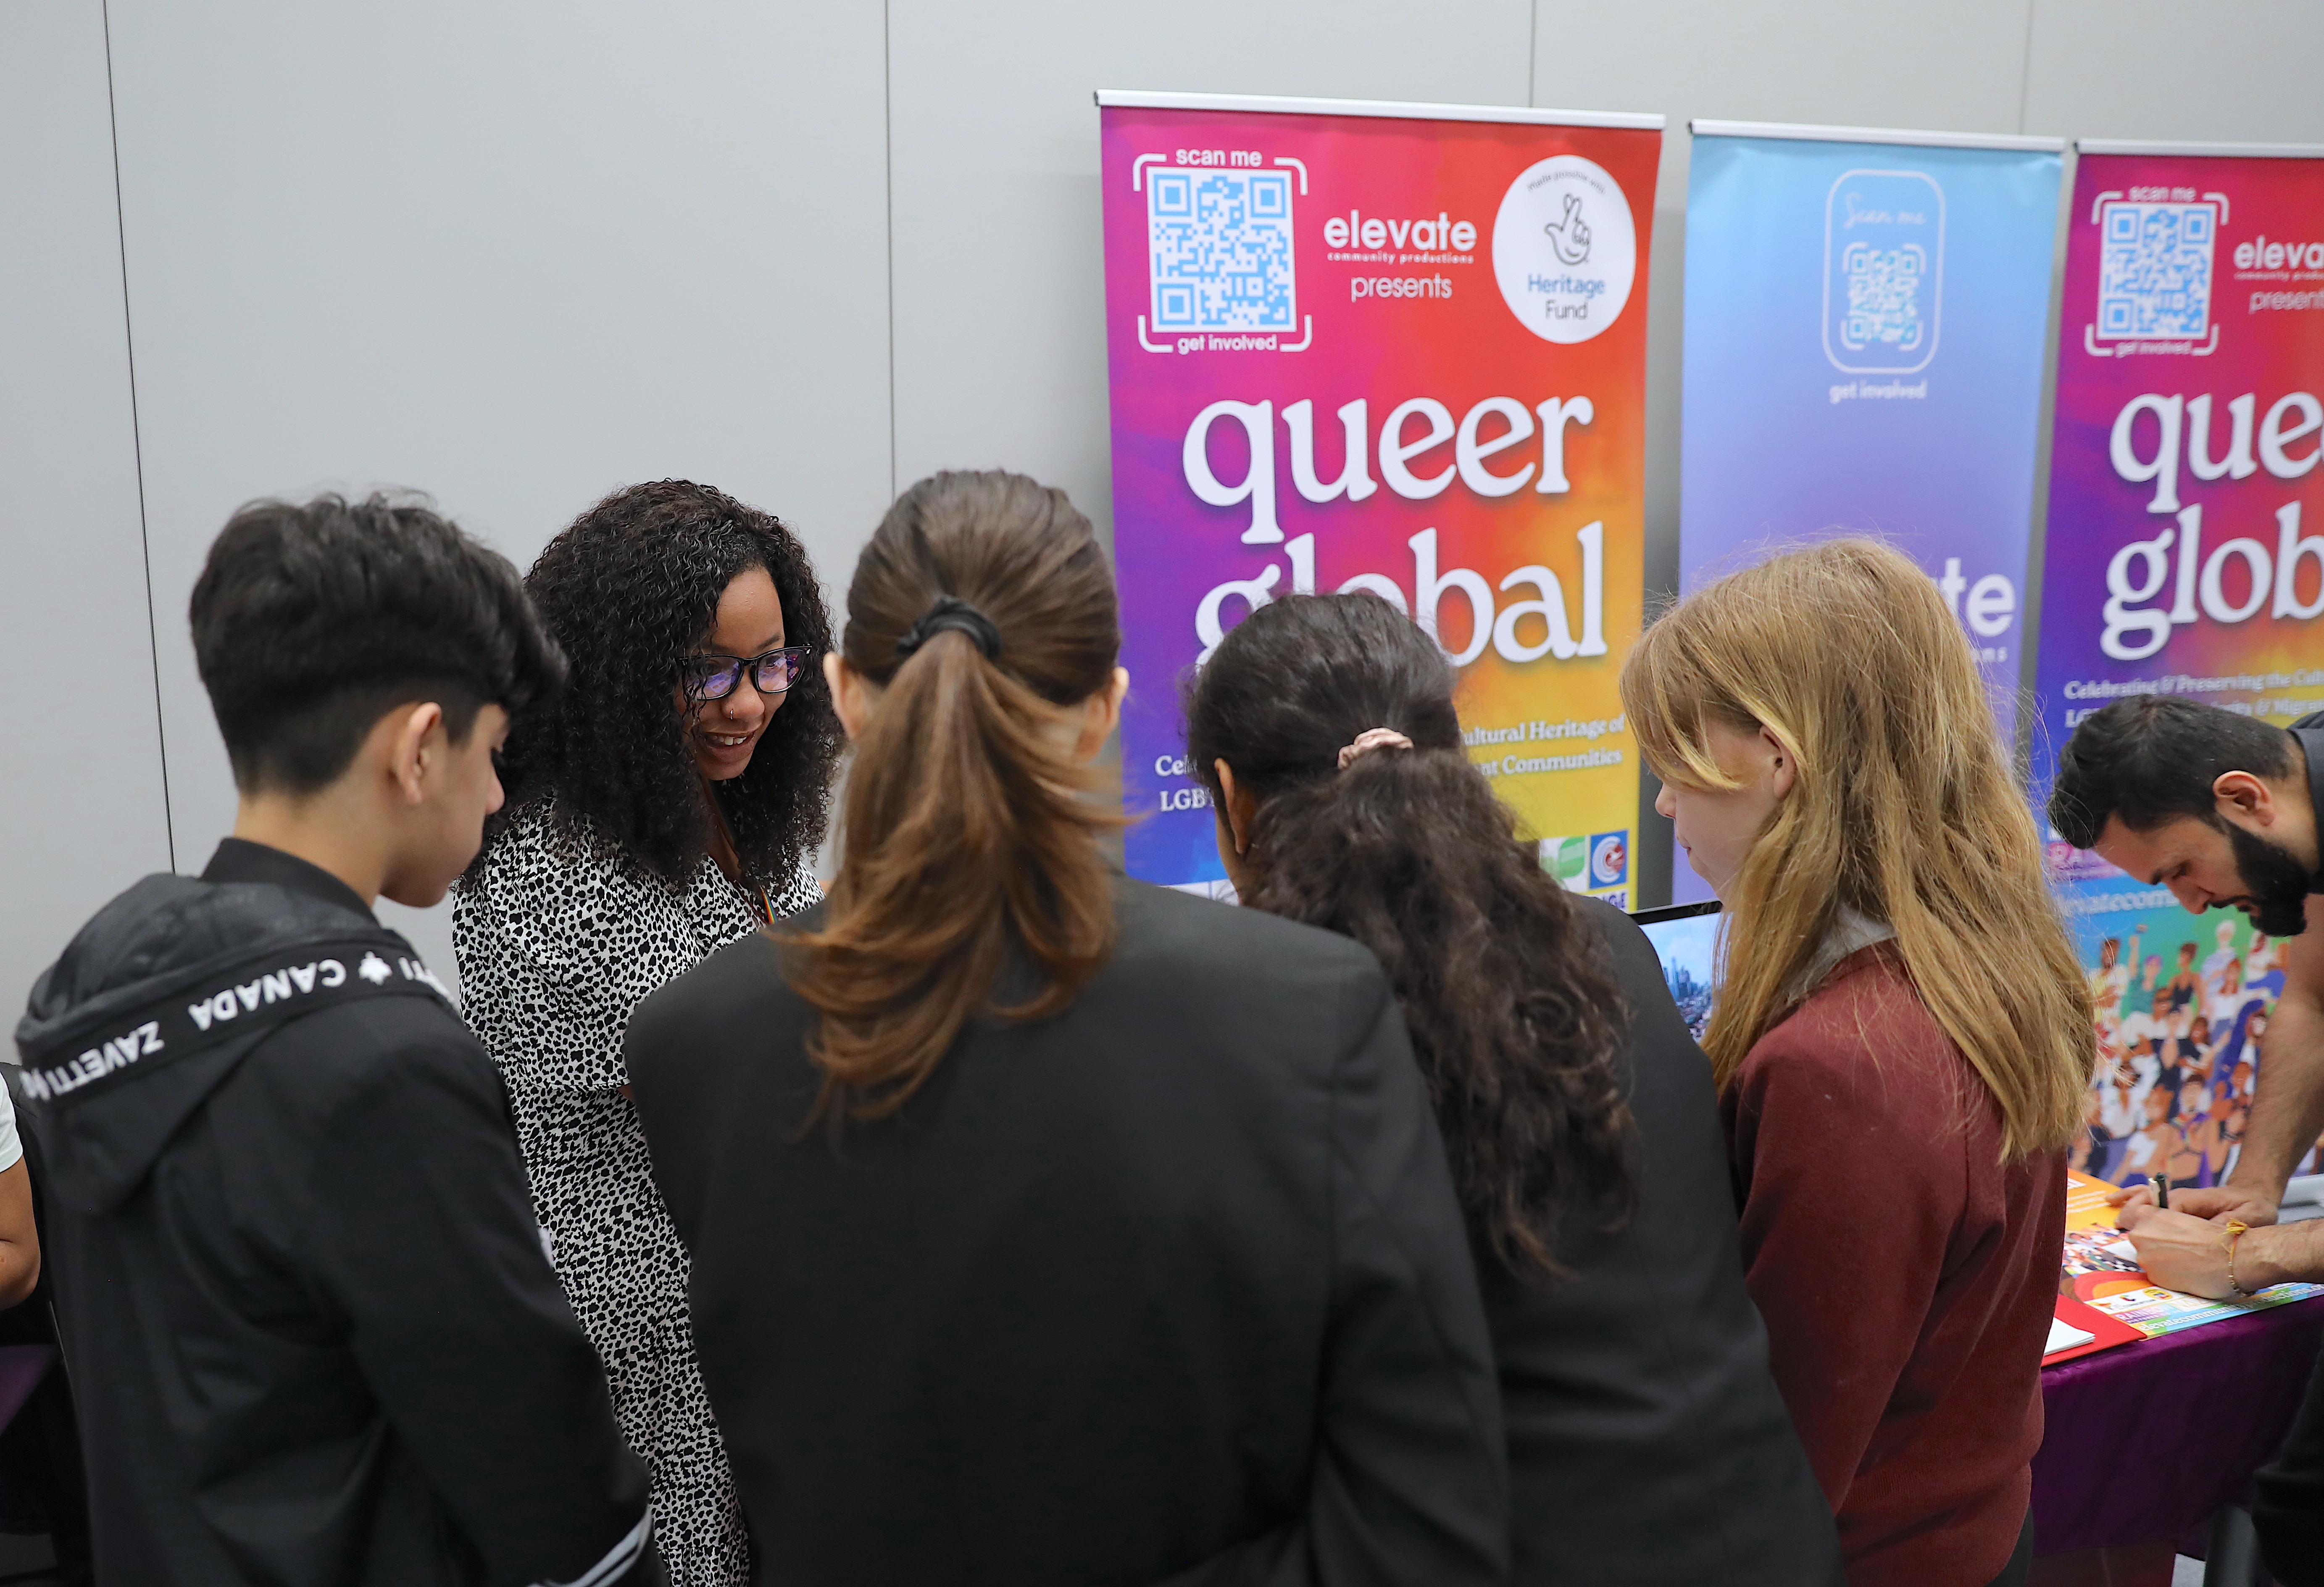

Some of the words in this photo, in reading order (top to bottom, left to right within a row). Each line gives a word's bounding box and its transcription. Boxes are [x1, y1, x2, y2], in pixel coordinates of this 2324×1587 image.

[1175, 148, 1226, 167] scan
[1231, 150, 1263, 168] me
[2129, 186, 2169, 203] scan
[2171, 187, 2197, 203] me
[1324, 208, 1477, 251] elevate
[1326, 250, 1396, 265] community
[1399, 251, 1474, 265] productions
[1350, 273, 1453, 303] presents
[1528, 274, 1605, 299] Heritage
[1545, 300, 1588, 321] Fund
[1177, 335, 1206, 355] get
[1208, 334, 1277, 352] involved
[1829, 384, 1856, 404] get
[1859, 380, 1928, 399] involved
[2109, 391, 2324, 513] que
[1182, 395, 1595, 544] queer
[1459, 718, 1526, 746] ultural
[1529, 719, 1608, 741] Heritage
[1608, 712, 1626, 733] of
[1502, 747, 1623, 775] Communities
[187, 958, 347, 1031] CANADA
